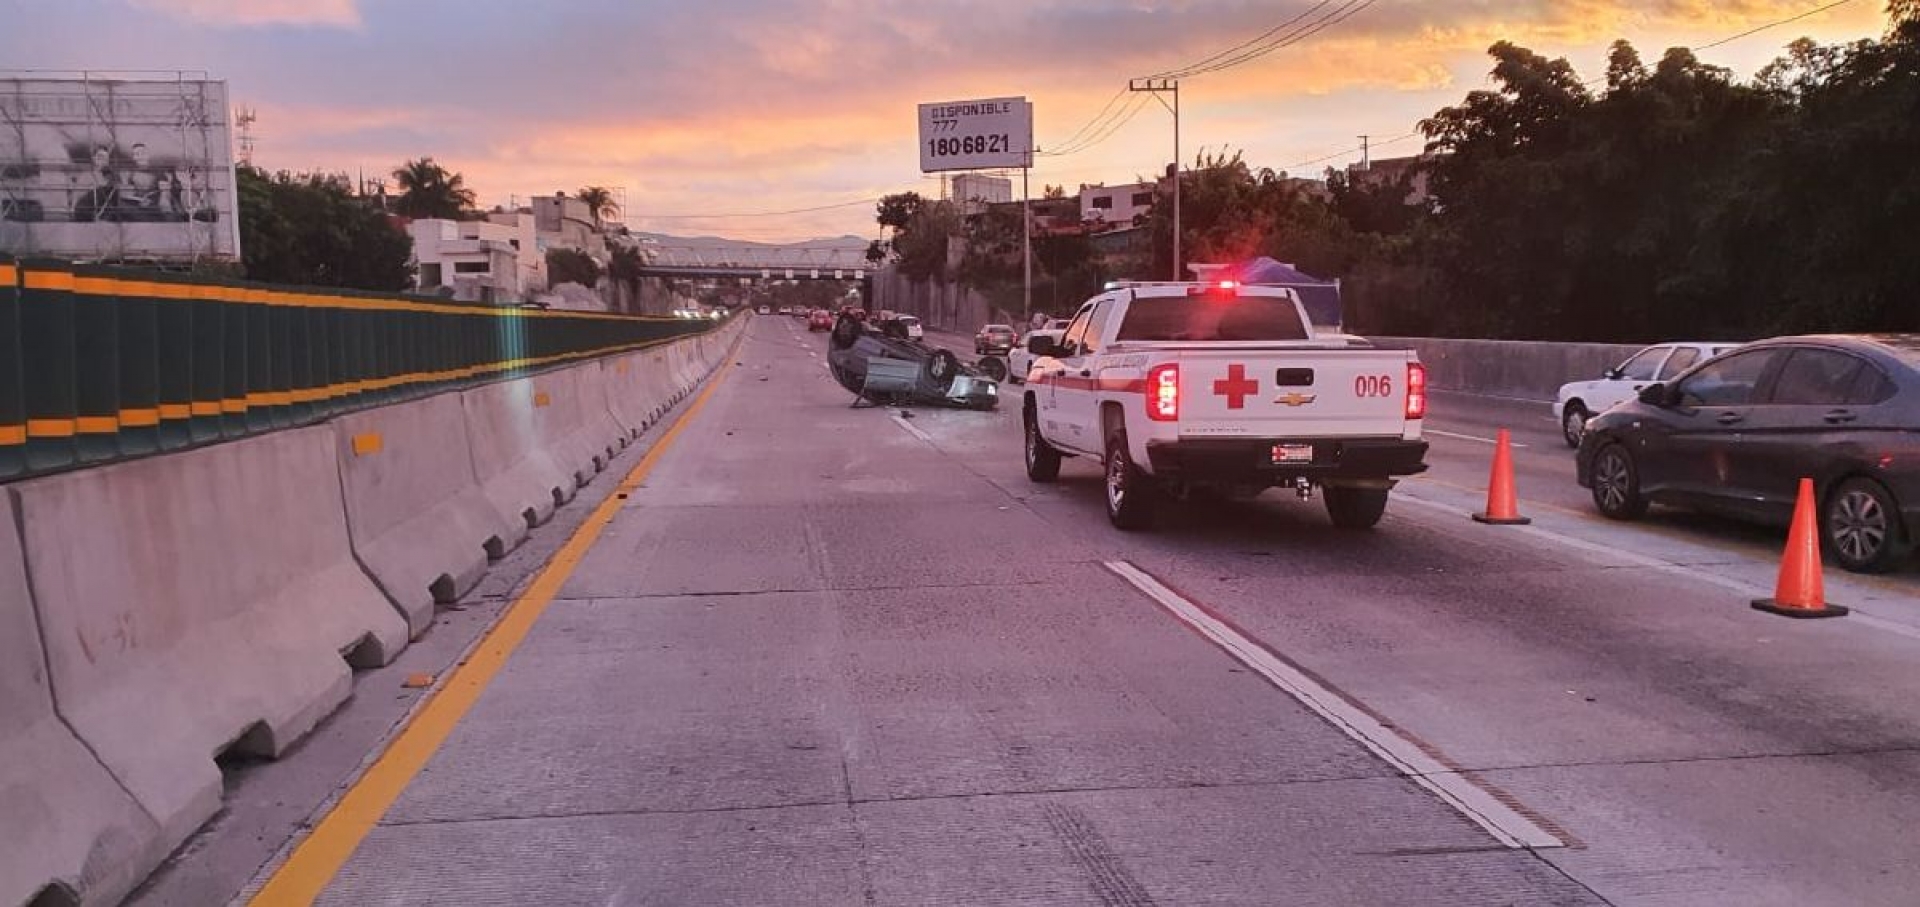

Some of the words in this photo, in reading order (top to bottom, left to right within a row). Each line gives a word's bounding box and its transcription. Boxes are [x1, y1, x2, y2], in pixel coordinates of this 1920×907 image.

[931, 102, 1011, 119] DISPONIBLE
[932, 119, 958, 133] 777
[1355, 375, 1391, 398] 006
